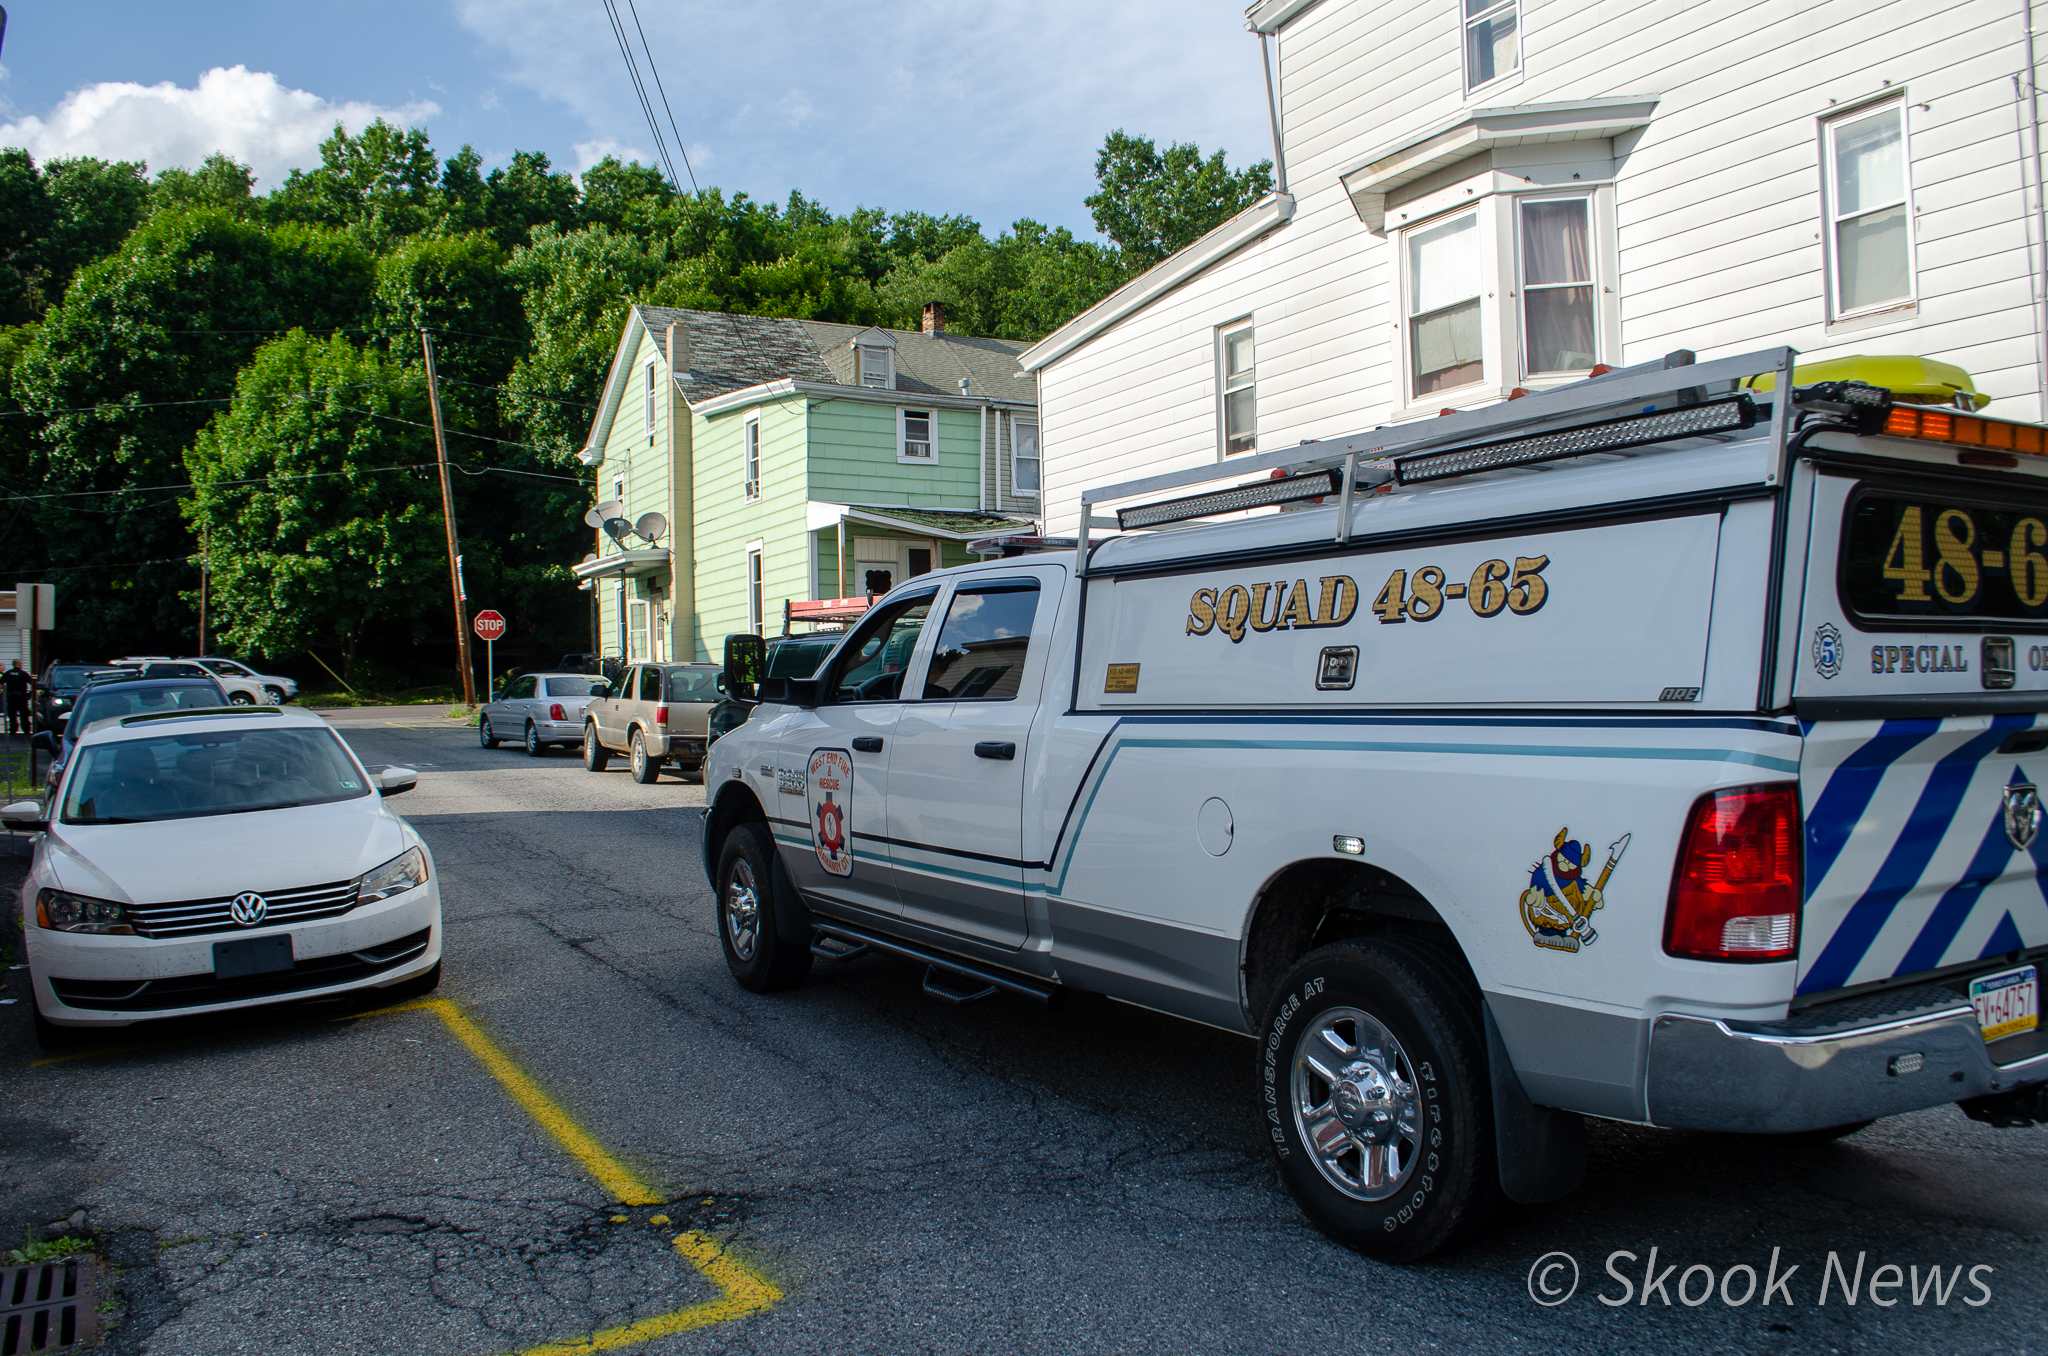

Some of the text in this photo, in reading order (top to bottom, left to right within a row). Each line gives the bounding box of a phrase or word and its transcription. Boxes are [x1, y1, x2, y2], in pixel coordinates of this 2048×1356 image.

[1883, 506, 2048, 607] 48-6
[1186, 554, 1551, 644] SQUAD 48-65
[477, 619, 503, 631] STOP
[1822, 641, 1835, 664] 5
[1871, 645, 1968, 674] SPECIAL
[810, 752, 851, 779] WEST END FIRE
[819, 777, 840, 791] RESCUE
[1264, 977, 1325, 1159] TRANSFORCE AT
